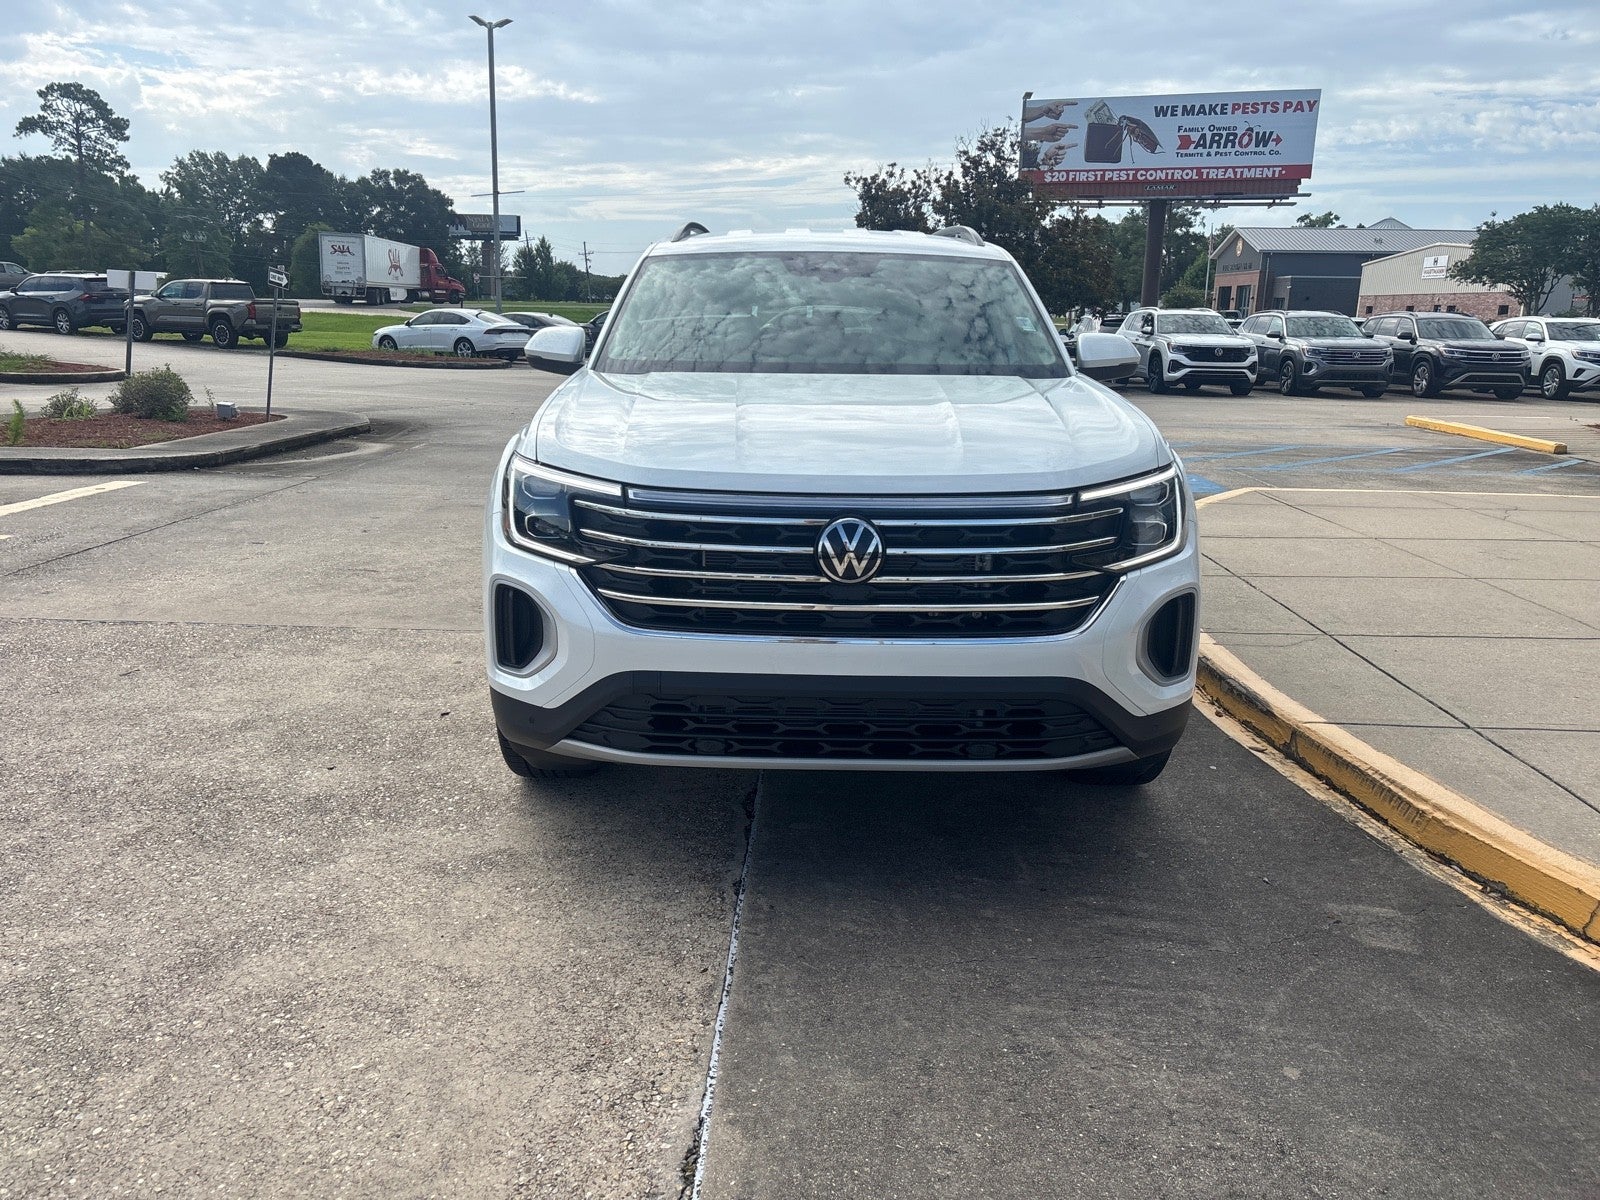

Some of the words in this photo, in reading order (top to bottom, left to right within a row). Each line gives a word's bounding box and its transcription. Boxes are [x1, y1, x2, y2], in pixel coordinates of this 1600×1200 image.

[1153, 105, 1178, 117] WE
[1181, 103, 1228, 116] MAKE
[1231, 101, 1280, 115] PESTS
[1282, 100, 1317, 113] PAY
[1193, 130, 1274, 149] ARROW
[1044, 171, 1066, 182] $20
[1068, 171, 1103, 181] FIRST
[1104, 170, 1135, 181] PEST
[1137, 169, 1198, 180] CONTROL
[1145, 184, 1176, 192] LAMAR
[330, 244, 355, 256] SAIA
[388, 248, 403, 277] SAIA
[819, 519, 881, 582] VW
